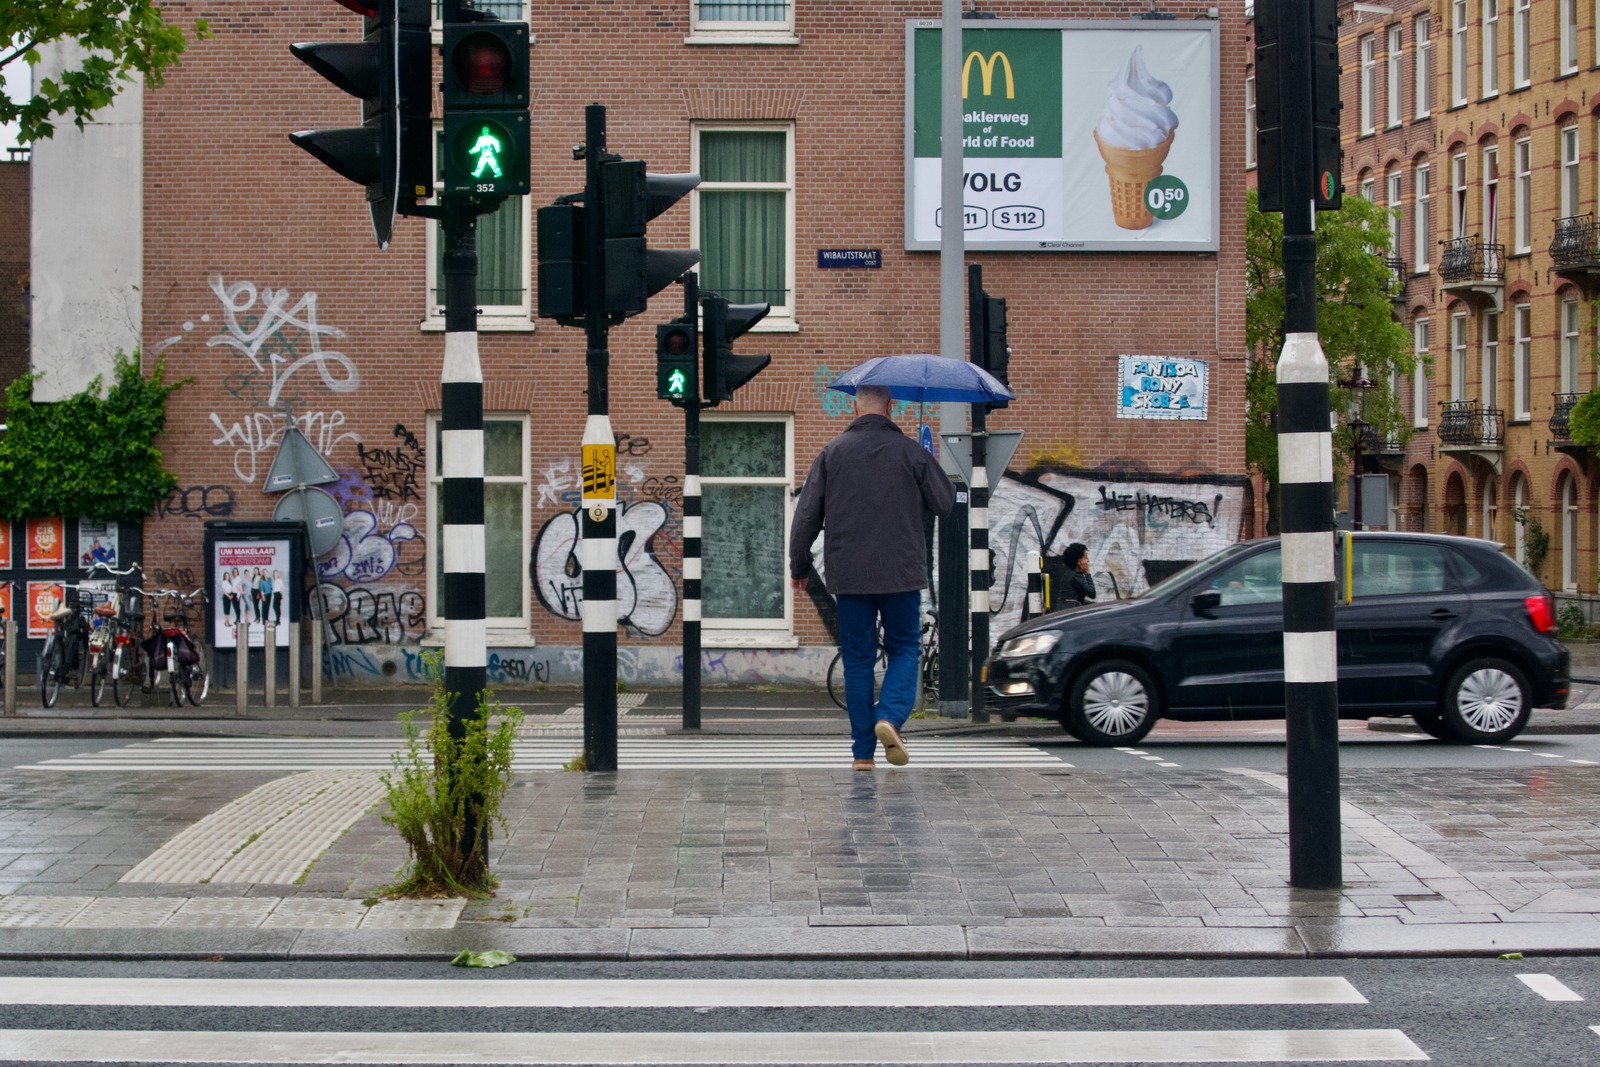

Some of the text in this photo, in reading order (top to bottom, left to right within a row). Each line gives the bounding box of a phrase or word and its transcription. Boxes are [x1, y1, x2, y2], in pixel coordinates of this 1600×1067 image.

[962, 111, 1029, 126] aklerweg
[982, 125, 993, 133] of
[983, 136, 998, 147] of
[1000, 136, 1035, 147] Food
[476, 183, 495, 192] 352
[1000, 211, 1037, 224] S 112
[823, 251, 877, 259] WIBAUTSTRAAT
[1141, 376, 1183, 394] RONY
[220, 548, 233, 556] UW
